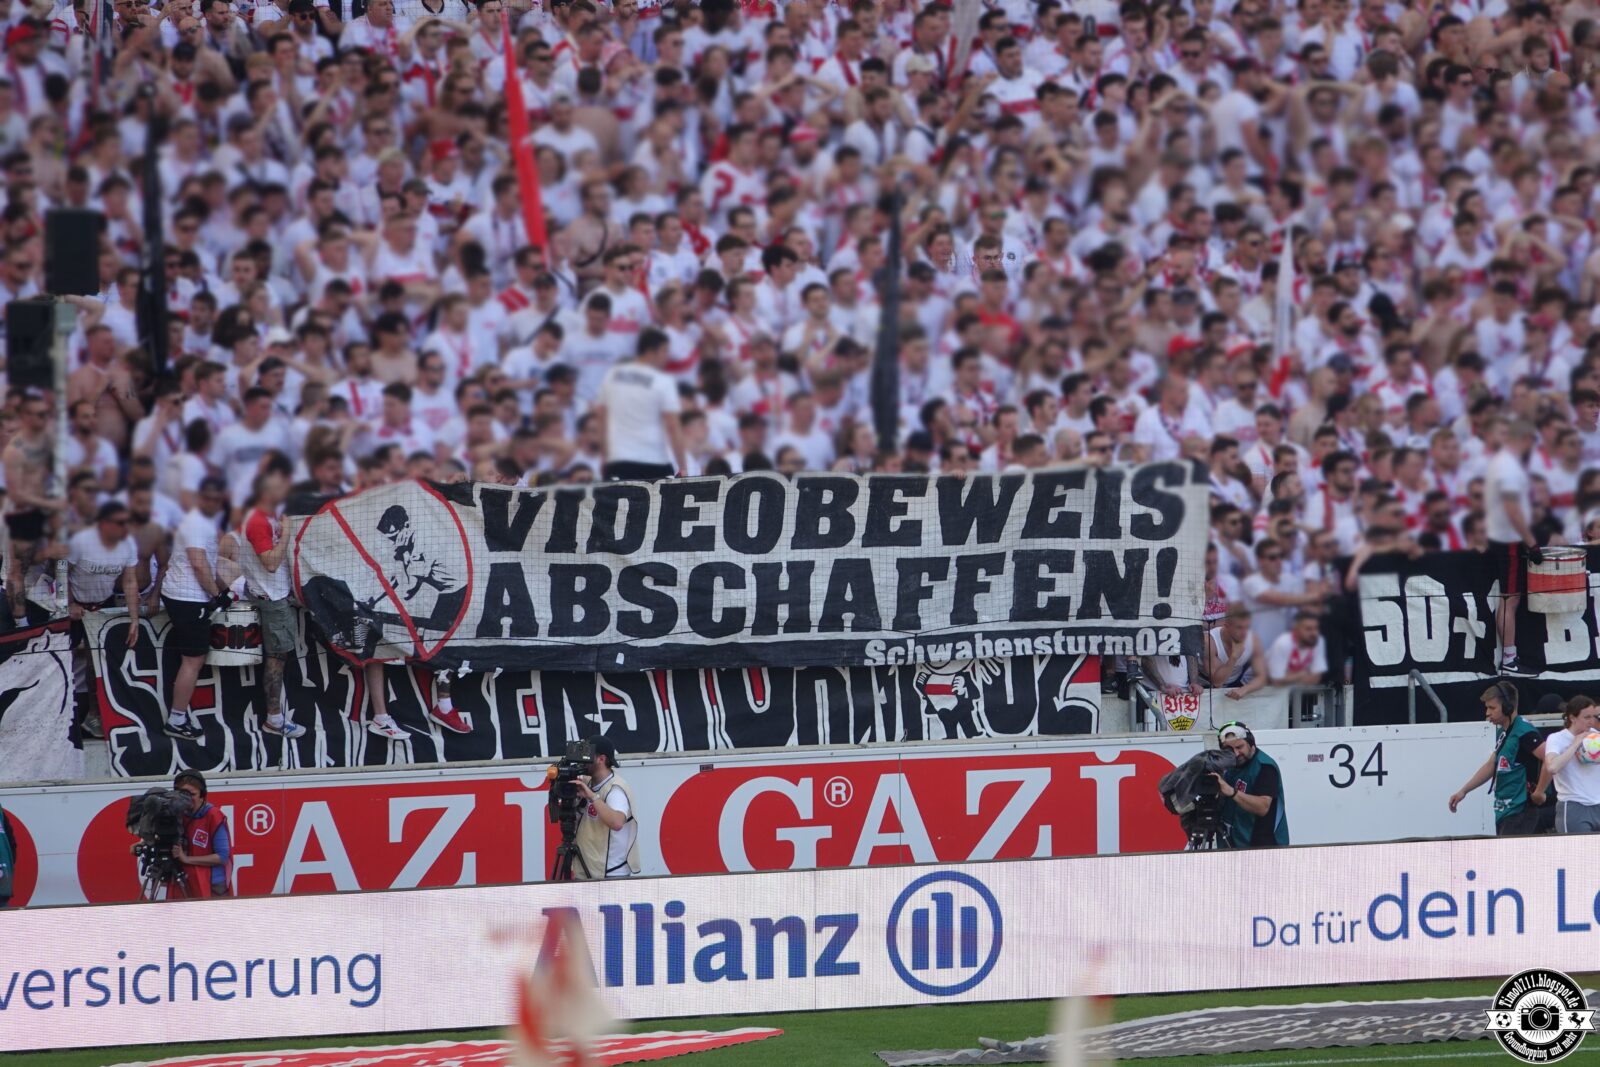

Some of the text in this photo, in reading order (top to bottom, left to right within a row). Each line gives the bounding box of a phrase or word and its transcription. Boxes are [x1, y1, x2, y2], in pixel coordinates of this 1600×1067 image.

[480, 461, 1186, 554] VIDEOBEWEIS
[476, 546, 1178, 639] ABSCHAFFEN!
[864, 627, 1181, 667] Schwabensturm02
[1329, 742, 1388, 788] 34
[531, 900, 860, 988] Allianz
[1253, 868, 1600, 947] Da für dein L
[0, 948, 382, 1010] versicherung
